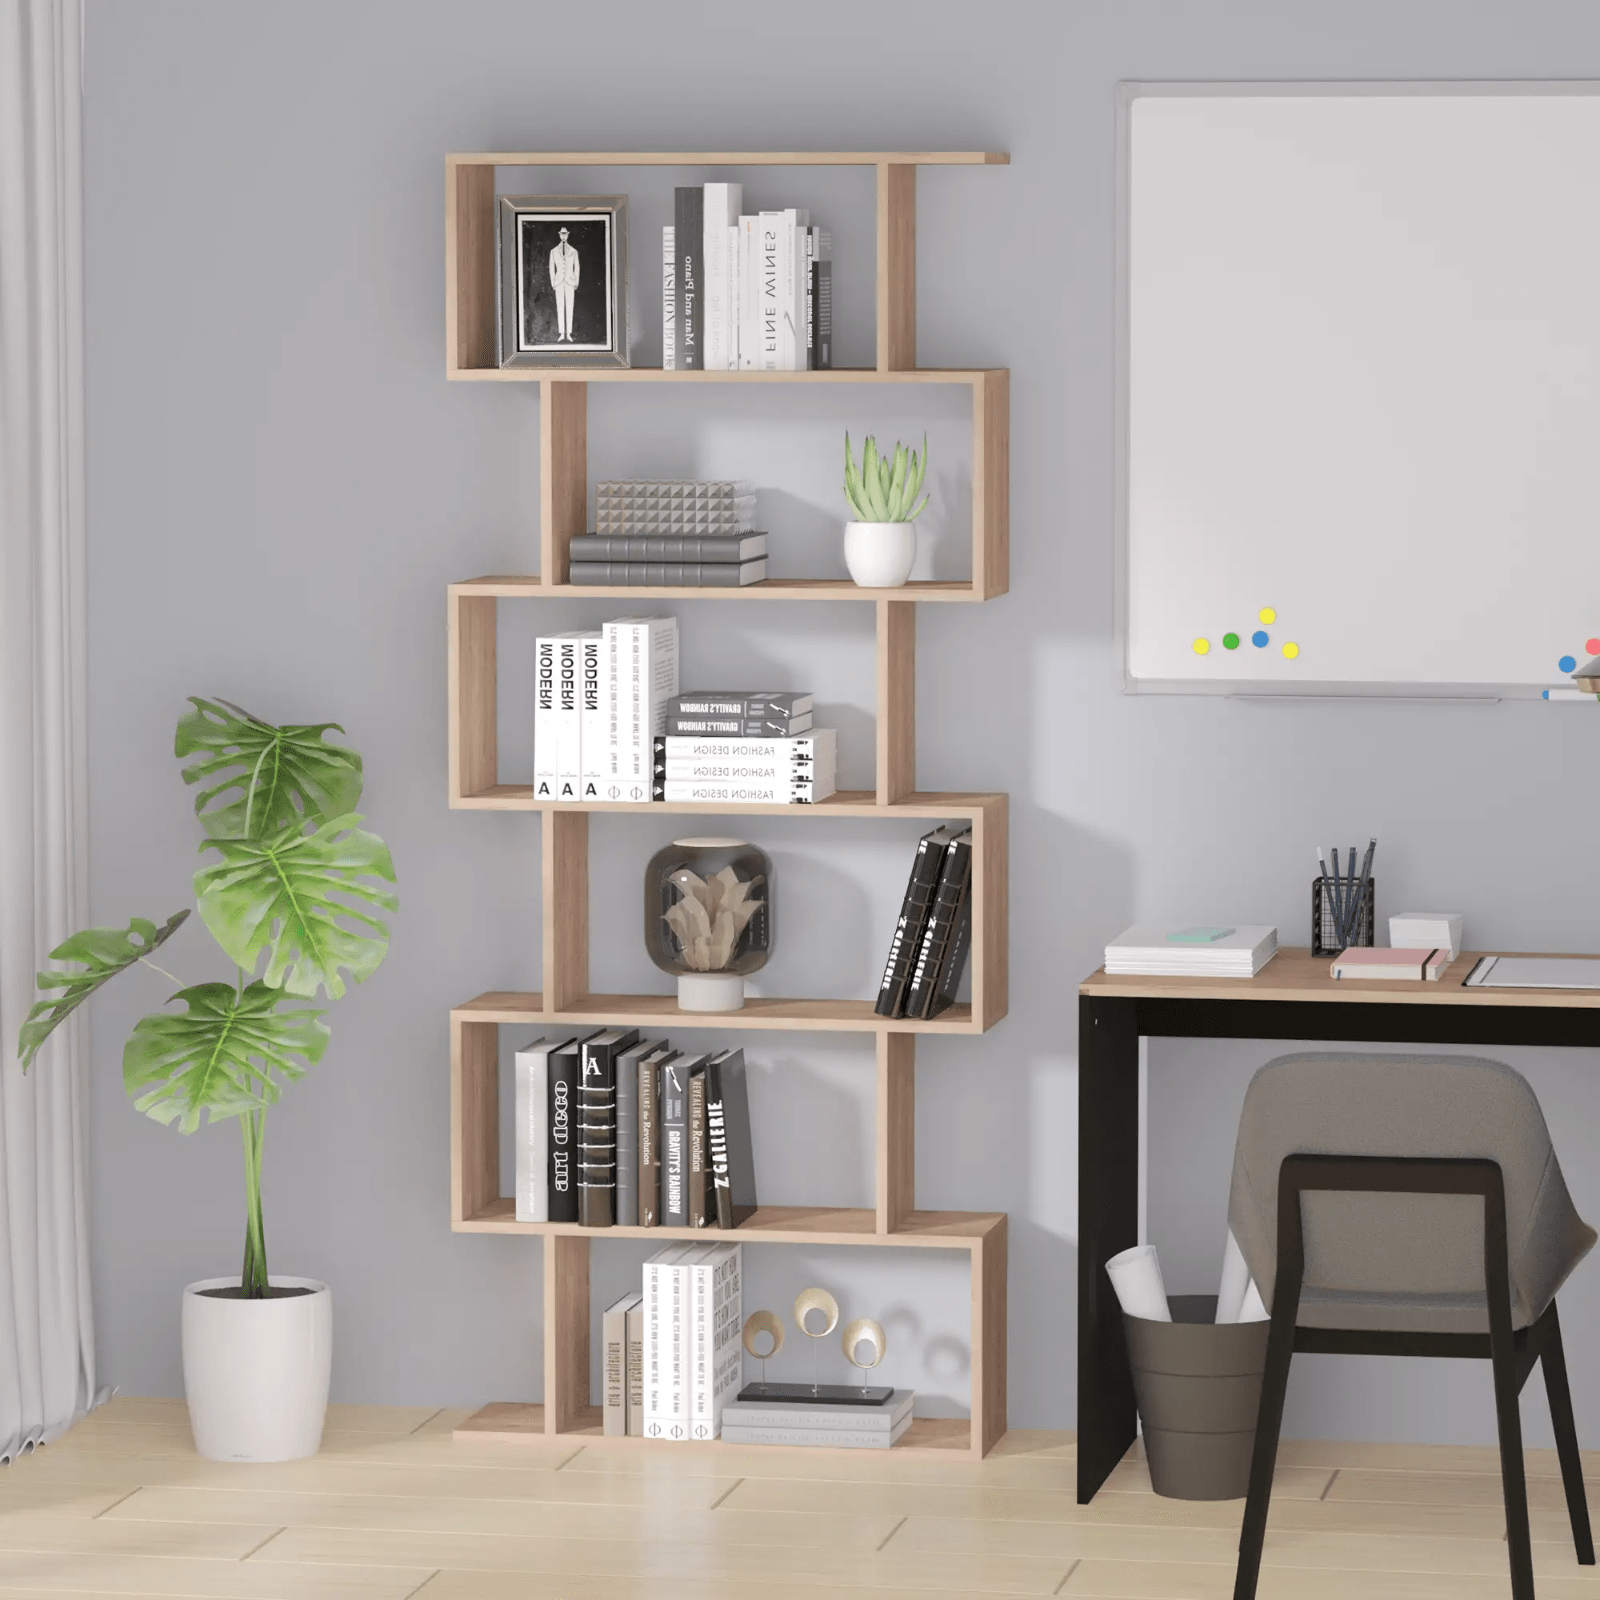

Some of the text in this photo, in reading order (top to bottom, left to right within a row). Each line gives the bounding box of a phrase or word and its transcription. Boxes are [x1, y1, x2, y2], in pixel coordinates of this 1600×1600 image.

[664, 262, 675, 323] FASHION
[538, 782, 550, 795] A
[561, 783, 573, 796] A
[585, 782, 597, 796] A
[587, 1057, 601, 1075] A
[553, 1080, 569, 1192] art deco
[692, 1081, 703, 1172] REVEALING the Revolution
[643, 1122, 651, 1165] Revolution
[669, 1131, 681, 1214] GRAVITY'S RAINBOW
[714, 1176, 730, 1188] Z
